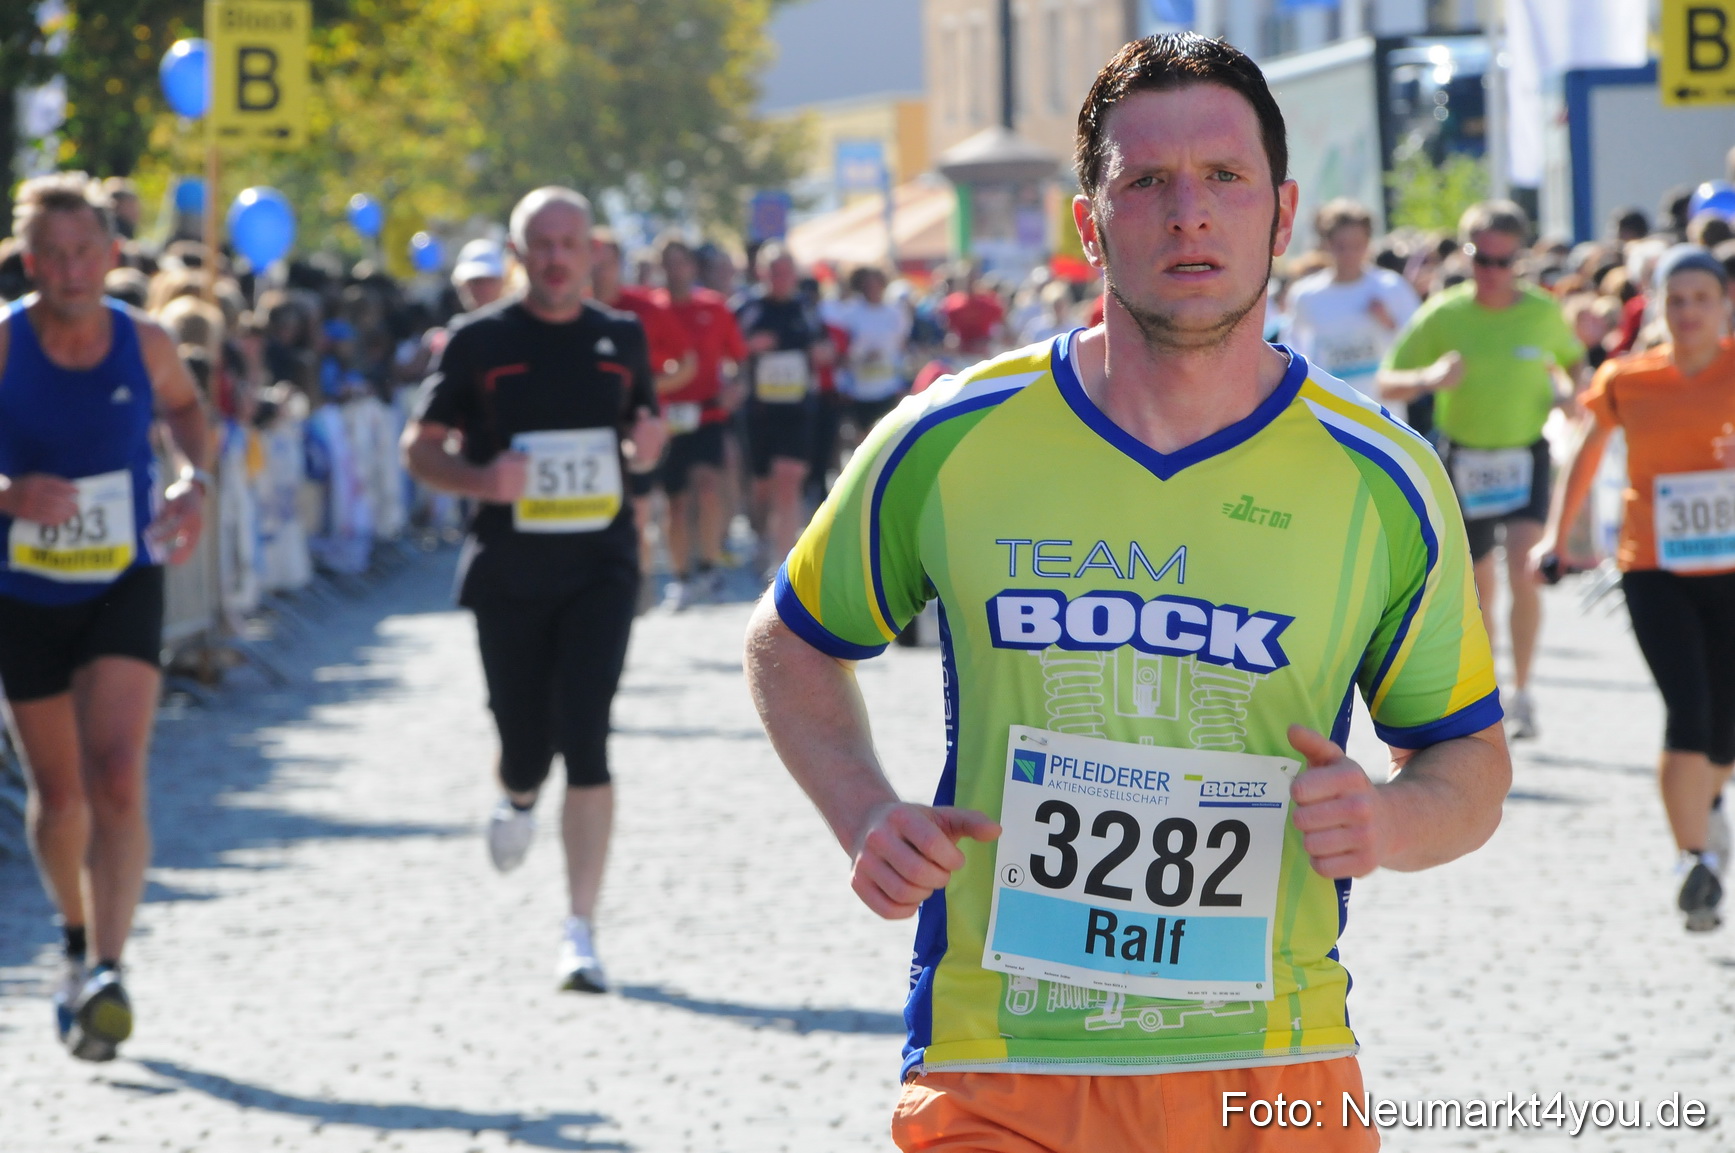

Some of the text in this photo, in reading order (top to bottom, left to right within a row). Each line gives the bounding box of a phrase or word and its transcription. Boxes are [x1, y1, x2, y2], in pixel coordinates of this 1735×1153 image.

[1687, 7, 1730, 71] B
[238, 47, 281, 112] B
[538, 456, 601, 497] 512
[1667, 497, 1735, 536] 308
[996, 539, 1187, 584] TEAM
[986, 588, 1296, 675] BOCK
[1047, 779, 1169, 806] AKTIENGESELLSCHAFT
[1050, 754, 1171, 792] PFLEIDERER
[1200, 781, 1267, 797] BOCK
[1029, 799, 1251, 907] 3282
[1085, 908, 1186, 965] Ralf
